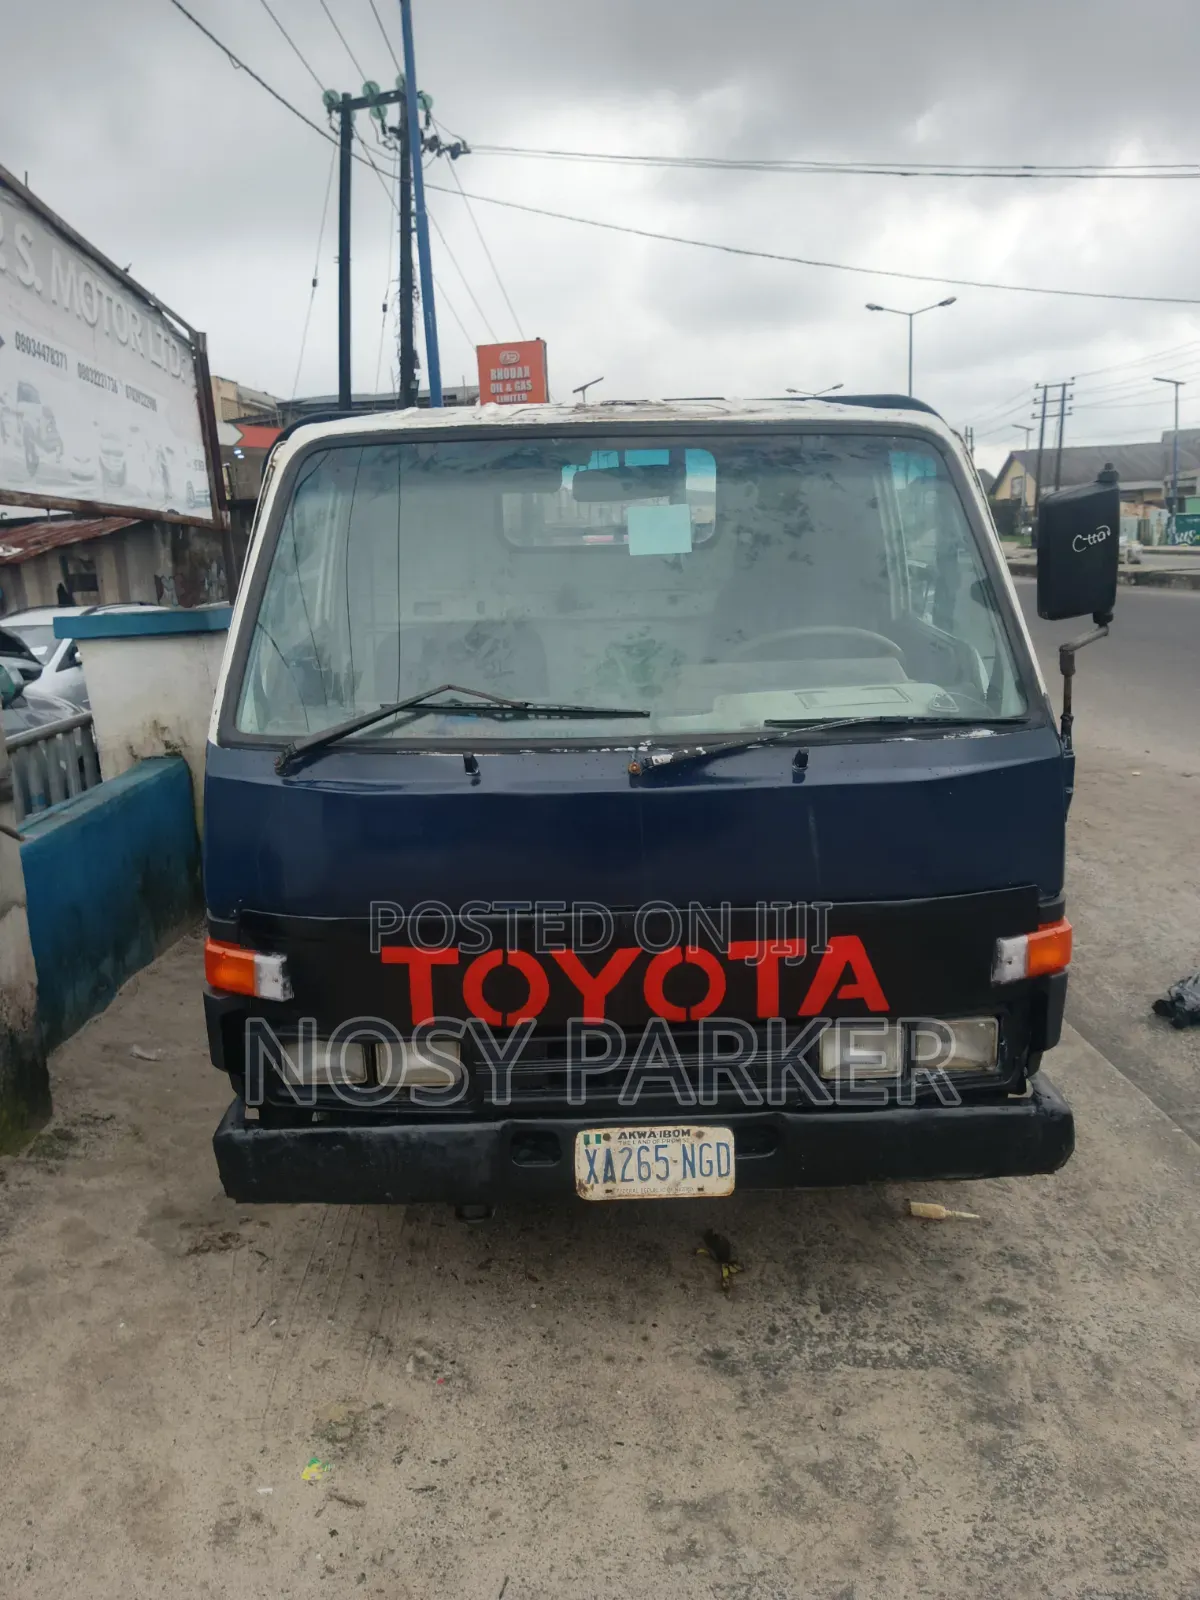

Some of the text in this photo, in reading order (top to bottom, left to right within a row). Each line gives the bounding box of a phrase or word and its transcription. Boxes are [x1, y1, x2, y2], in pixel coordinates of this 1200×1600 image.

[51, 247, 146, 359] MOTOR
[490, 379, 533, 394] OIL & GAS
[496, 392, 528, 403] LIMITED
[381, 935, 890, 1027] TOYOTA
